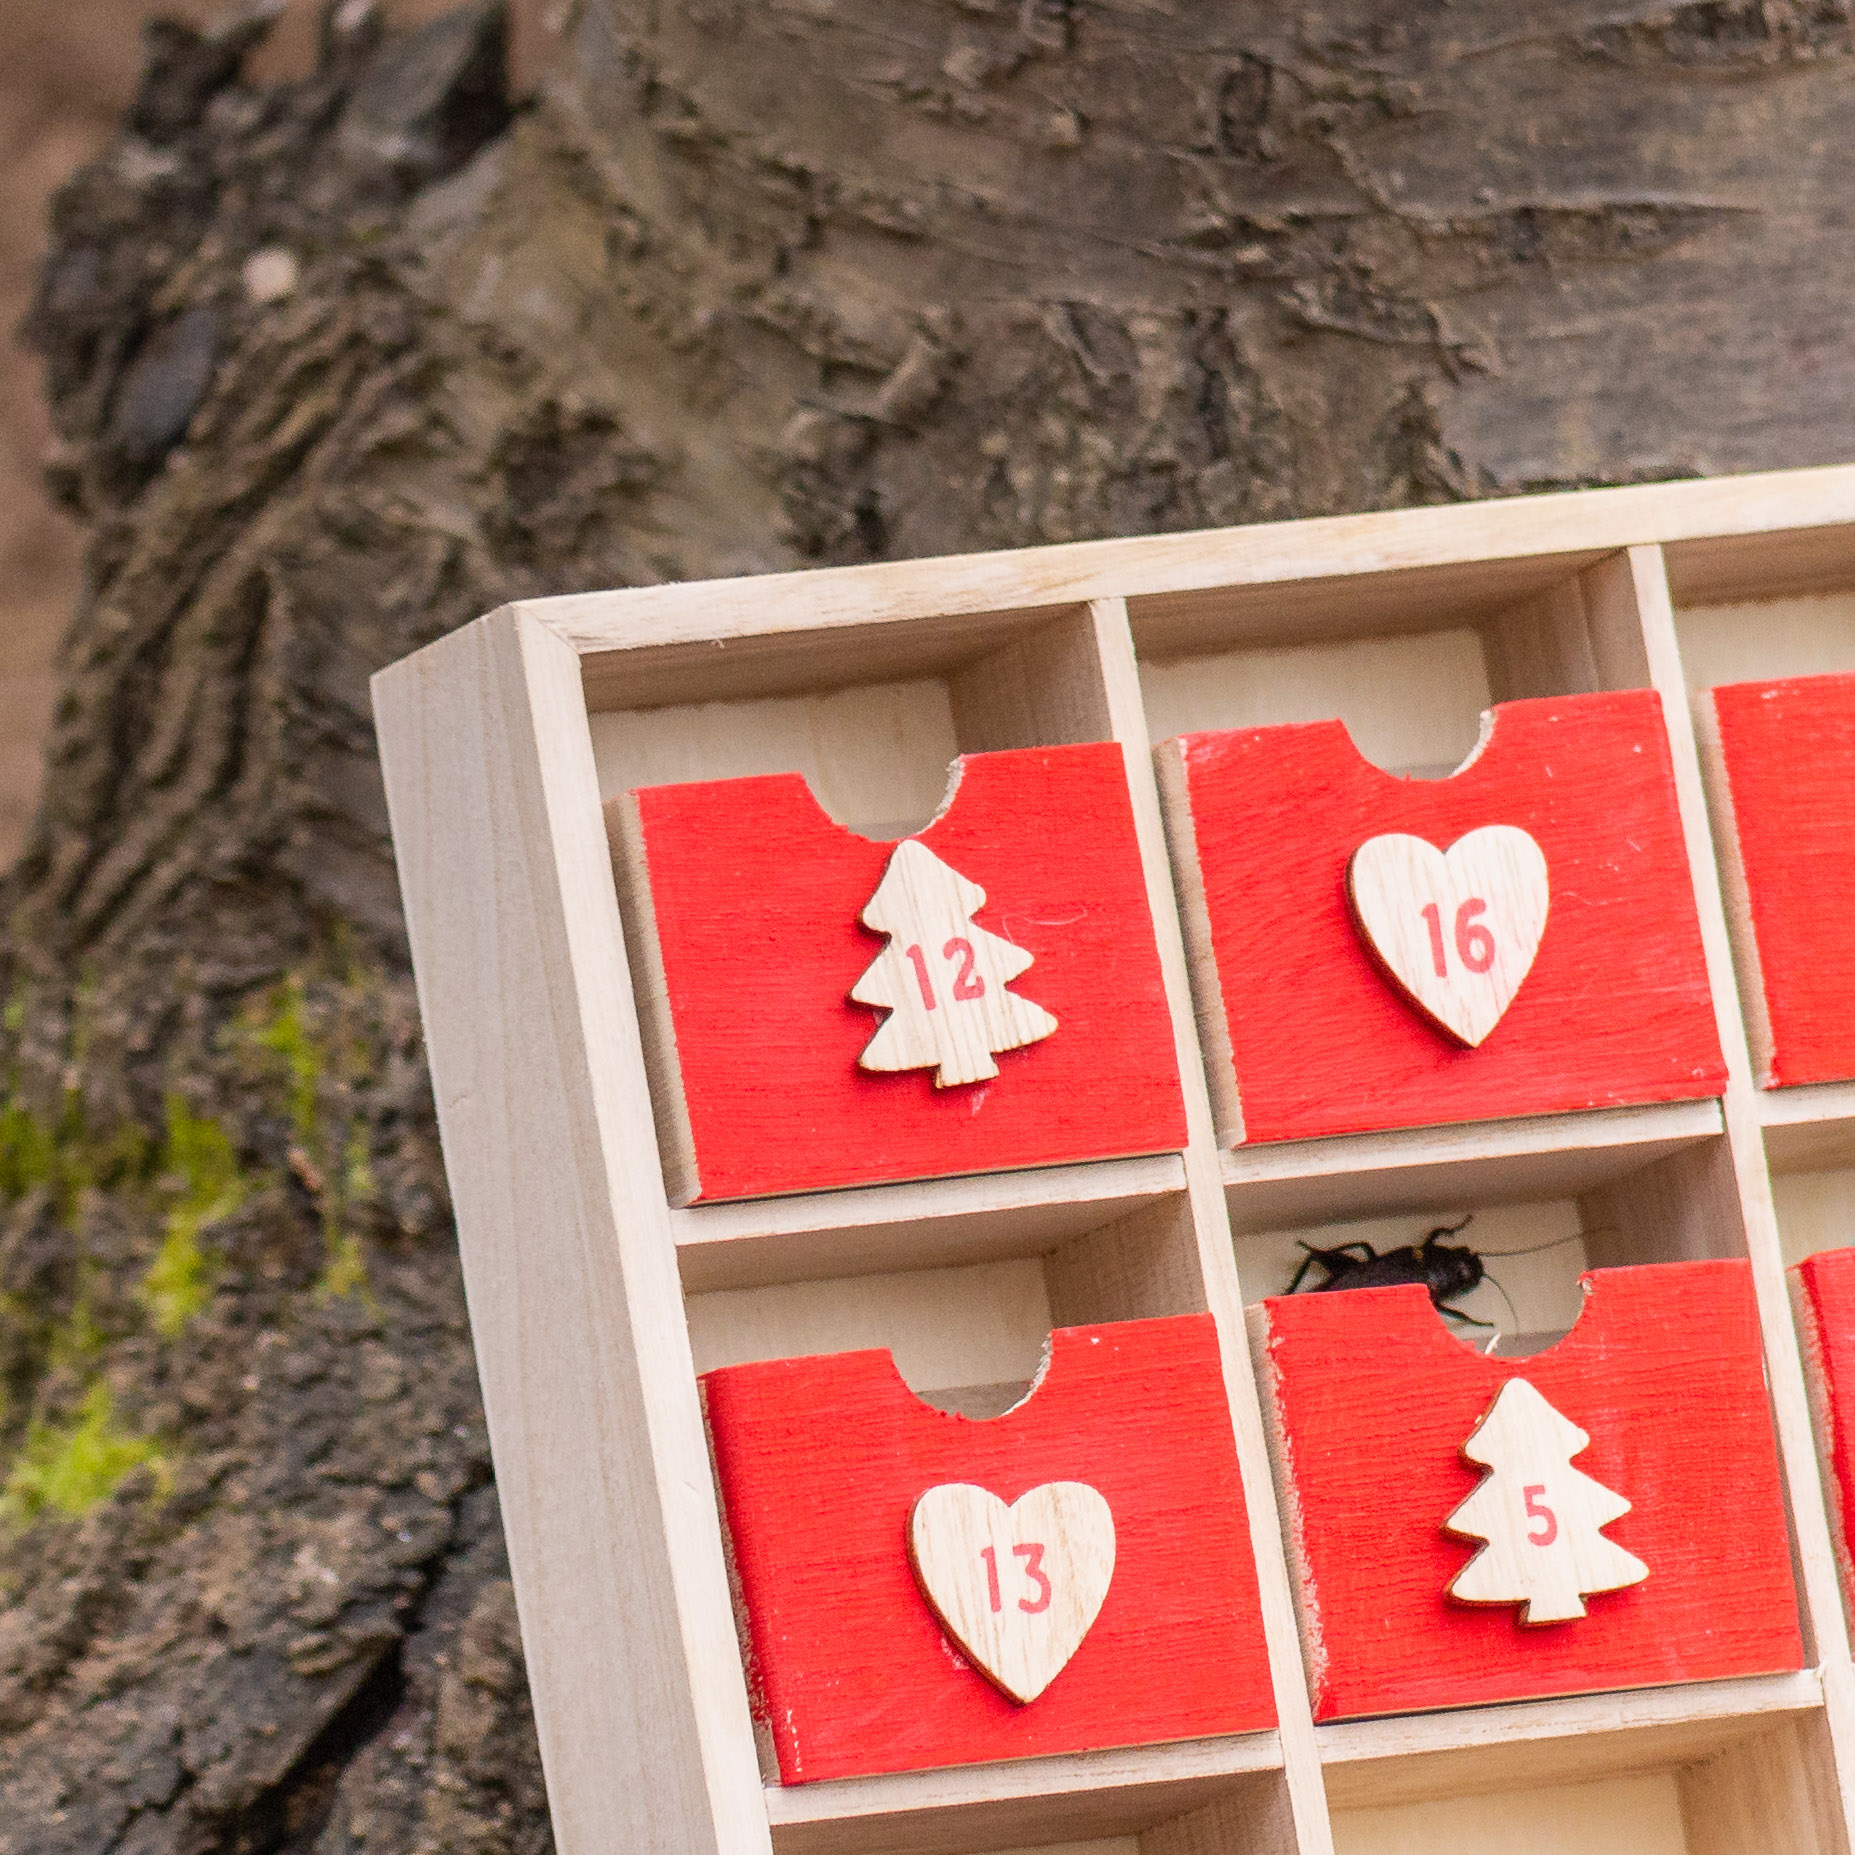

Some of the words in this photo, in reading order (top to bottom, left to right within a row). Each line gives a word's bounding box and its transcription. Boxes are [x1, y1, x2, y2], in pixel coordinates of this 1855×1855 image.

[906, 937, 985, 1011] 12
[1421, 898, 1496, 978] 16
[1523, 1485, 1558, 1547] 5
[980, 1543, 1052, 1614] 13
